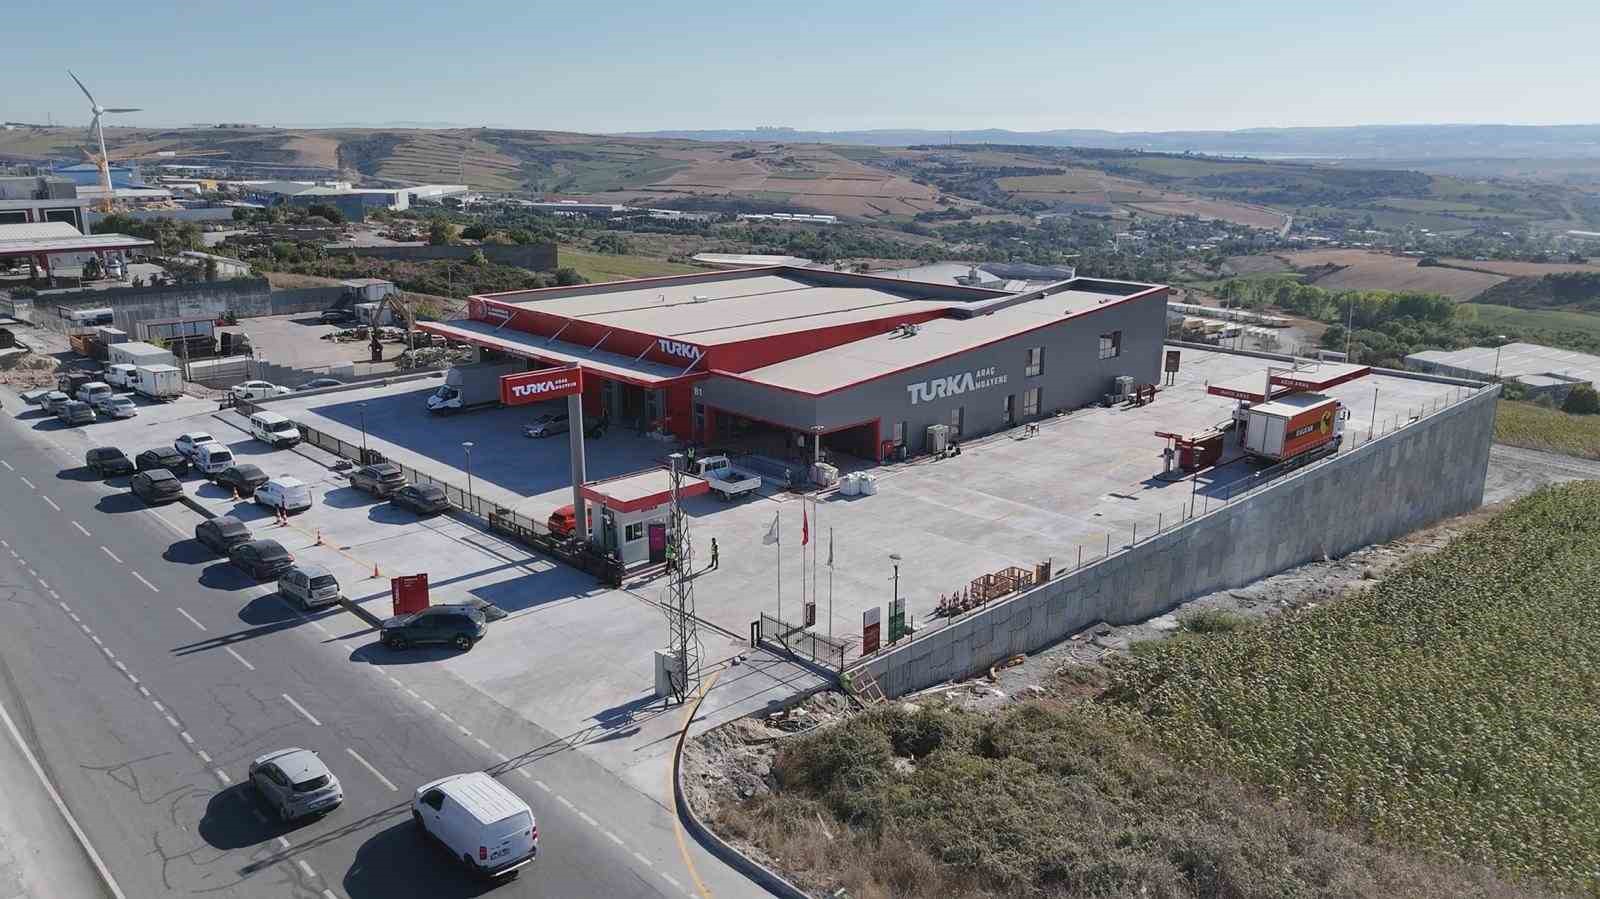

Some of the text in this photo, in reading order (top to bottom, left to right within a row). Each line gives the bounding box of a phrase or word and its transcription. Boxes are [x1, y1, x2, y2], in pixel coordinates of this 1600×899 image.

[659, 339, 700, 360] TURKA
[512, 381, 556, 397] TURKA
[907, 372, 976, 404] TURKA
